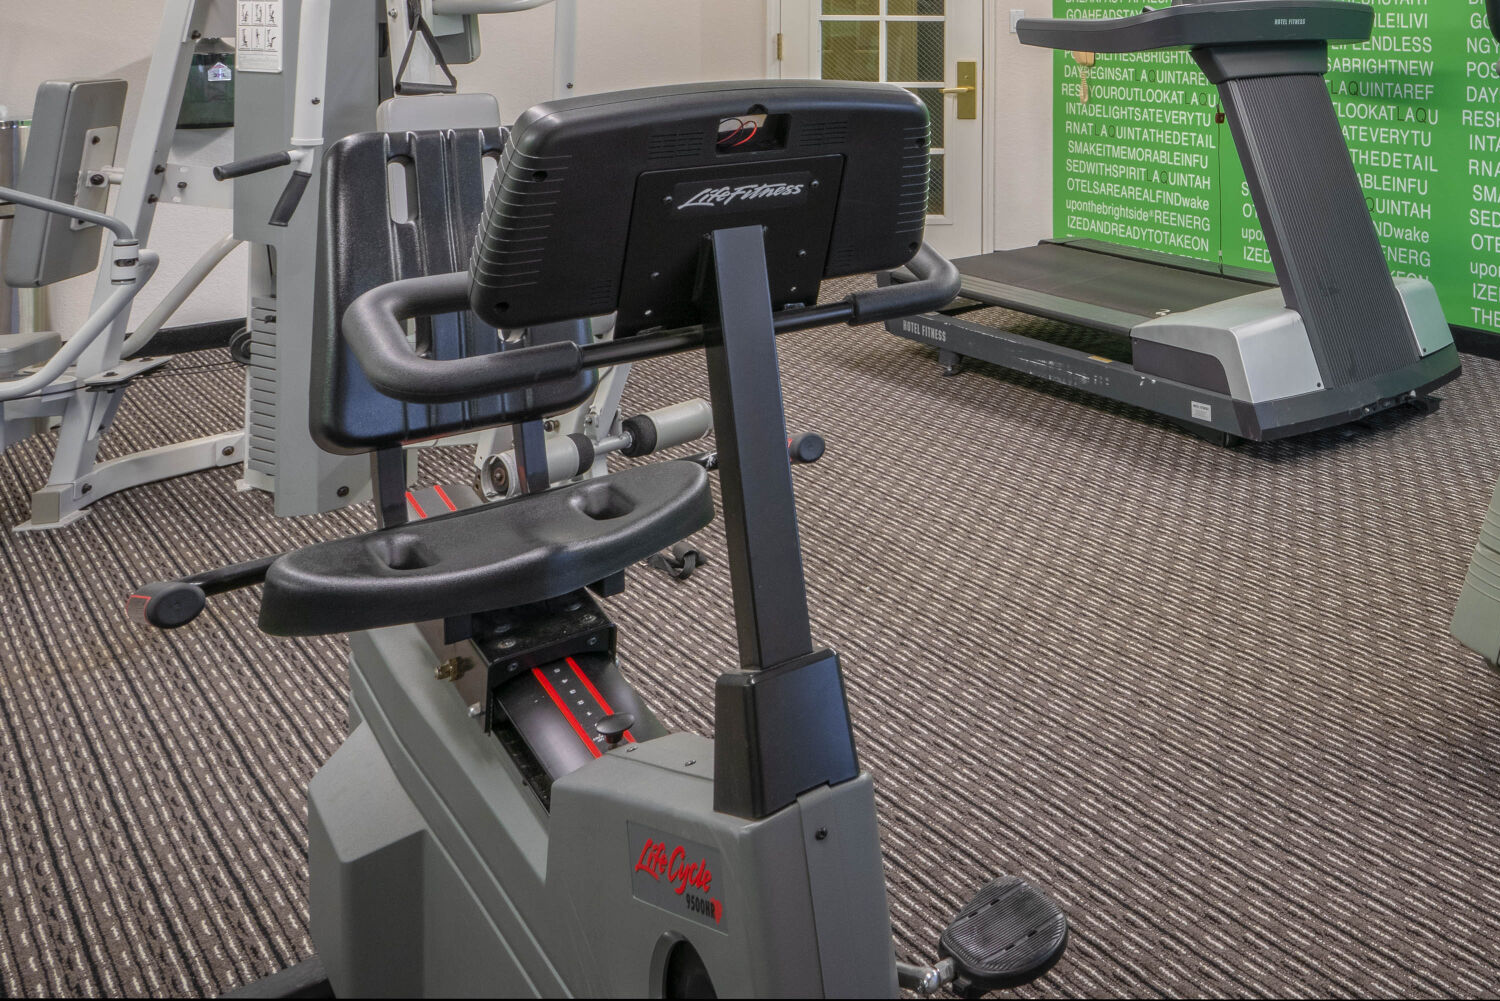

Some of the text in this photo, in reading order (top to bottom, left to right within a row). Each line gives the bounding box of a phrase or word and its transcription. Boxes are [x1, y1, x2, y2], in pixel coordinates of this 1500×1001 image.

[1062, 83, 1216, 108] RESYOUROUTLOOKATLAQU
[903, 320, 946, 342] HOTEL FITNESS
